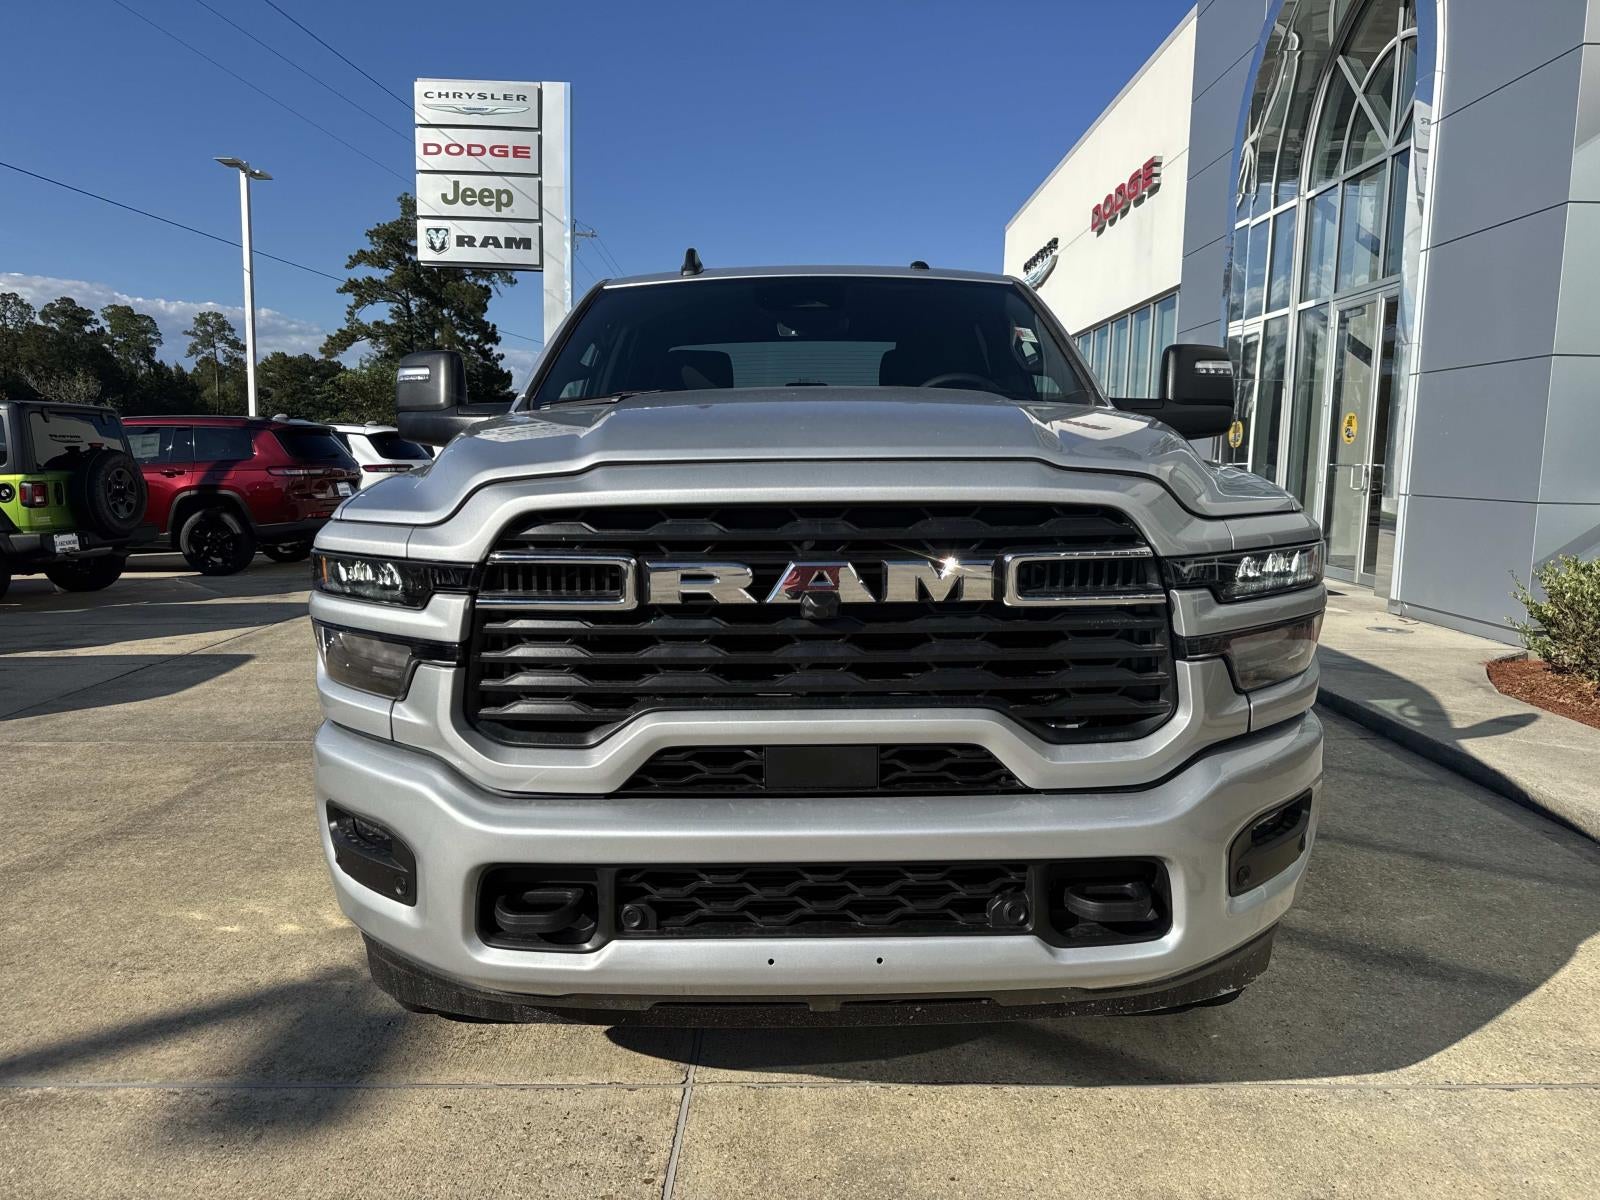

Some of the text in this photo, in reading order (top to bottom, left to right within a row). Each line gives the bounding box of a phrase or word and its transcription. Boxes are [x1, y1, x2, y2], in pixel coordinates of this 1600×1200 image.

[423, 91, 528, 102] CHRYSLER
[423, 142, 531, 159] DODGE
[441, 180, 514, 212] Jeep
[1091, 156, 1163, 232] DODGE
[455, 235, 532, 250] RAM
[646, 560, 995, 603] RAM
